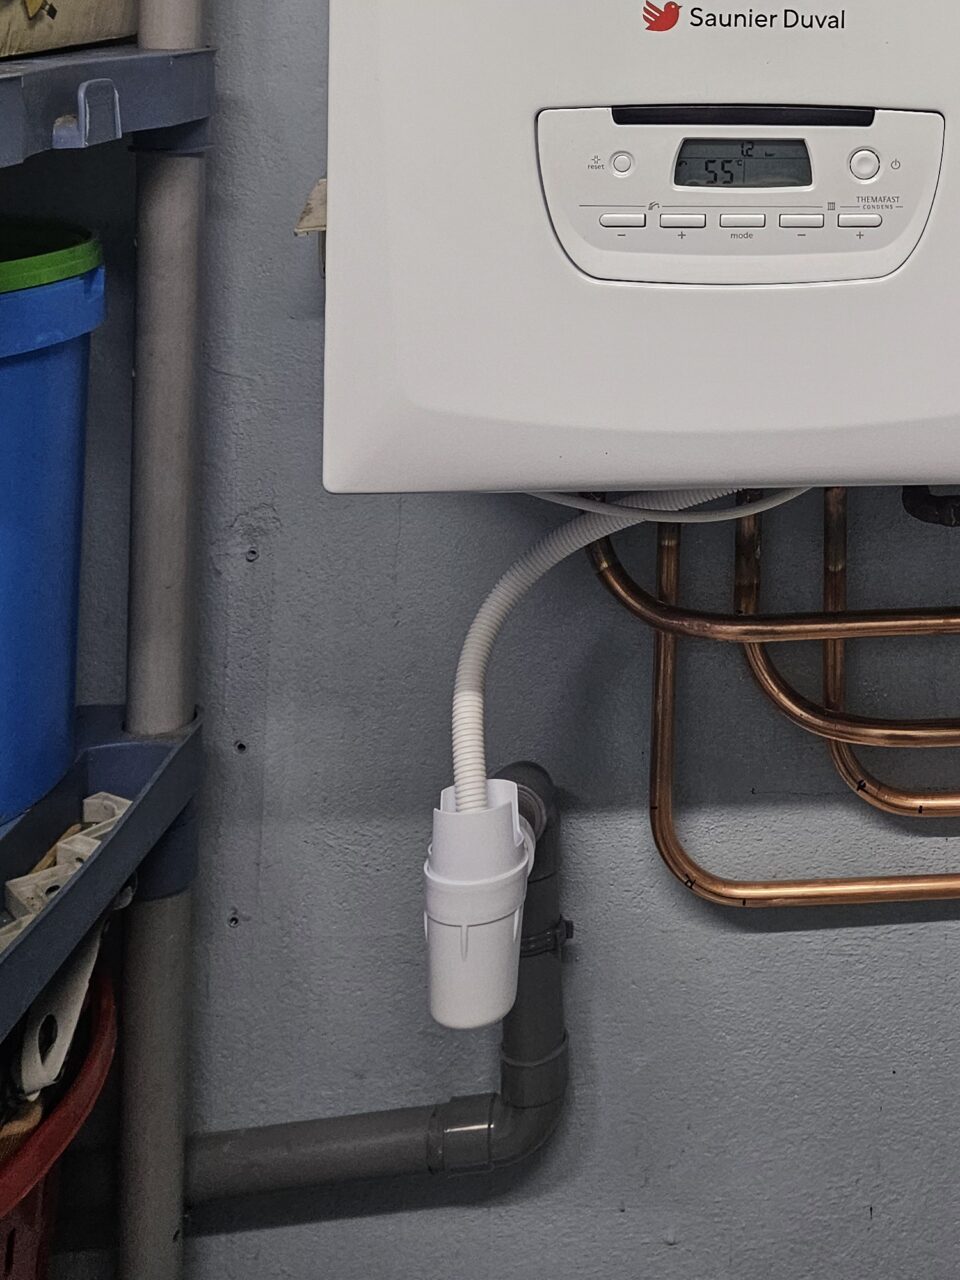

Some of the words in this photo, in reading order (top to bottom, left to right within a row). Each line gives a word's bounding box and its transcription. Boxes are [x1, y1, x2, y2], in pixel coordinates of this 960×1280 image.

[689, 7, 777, 28] Saunier
[783, 9, 845, 29] Duval
[856, 196, 900, 204] THEMAFAST
[730, 231, 754, 240] mode
